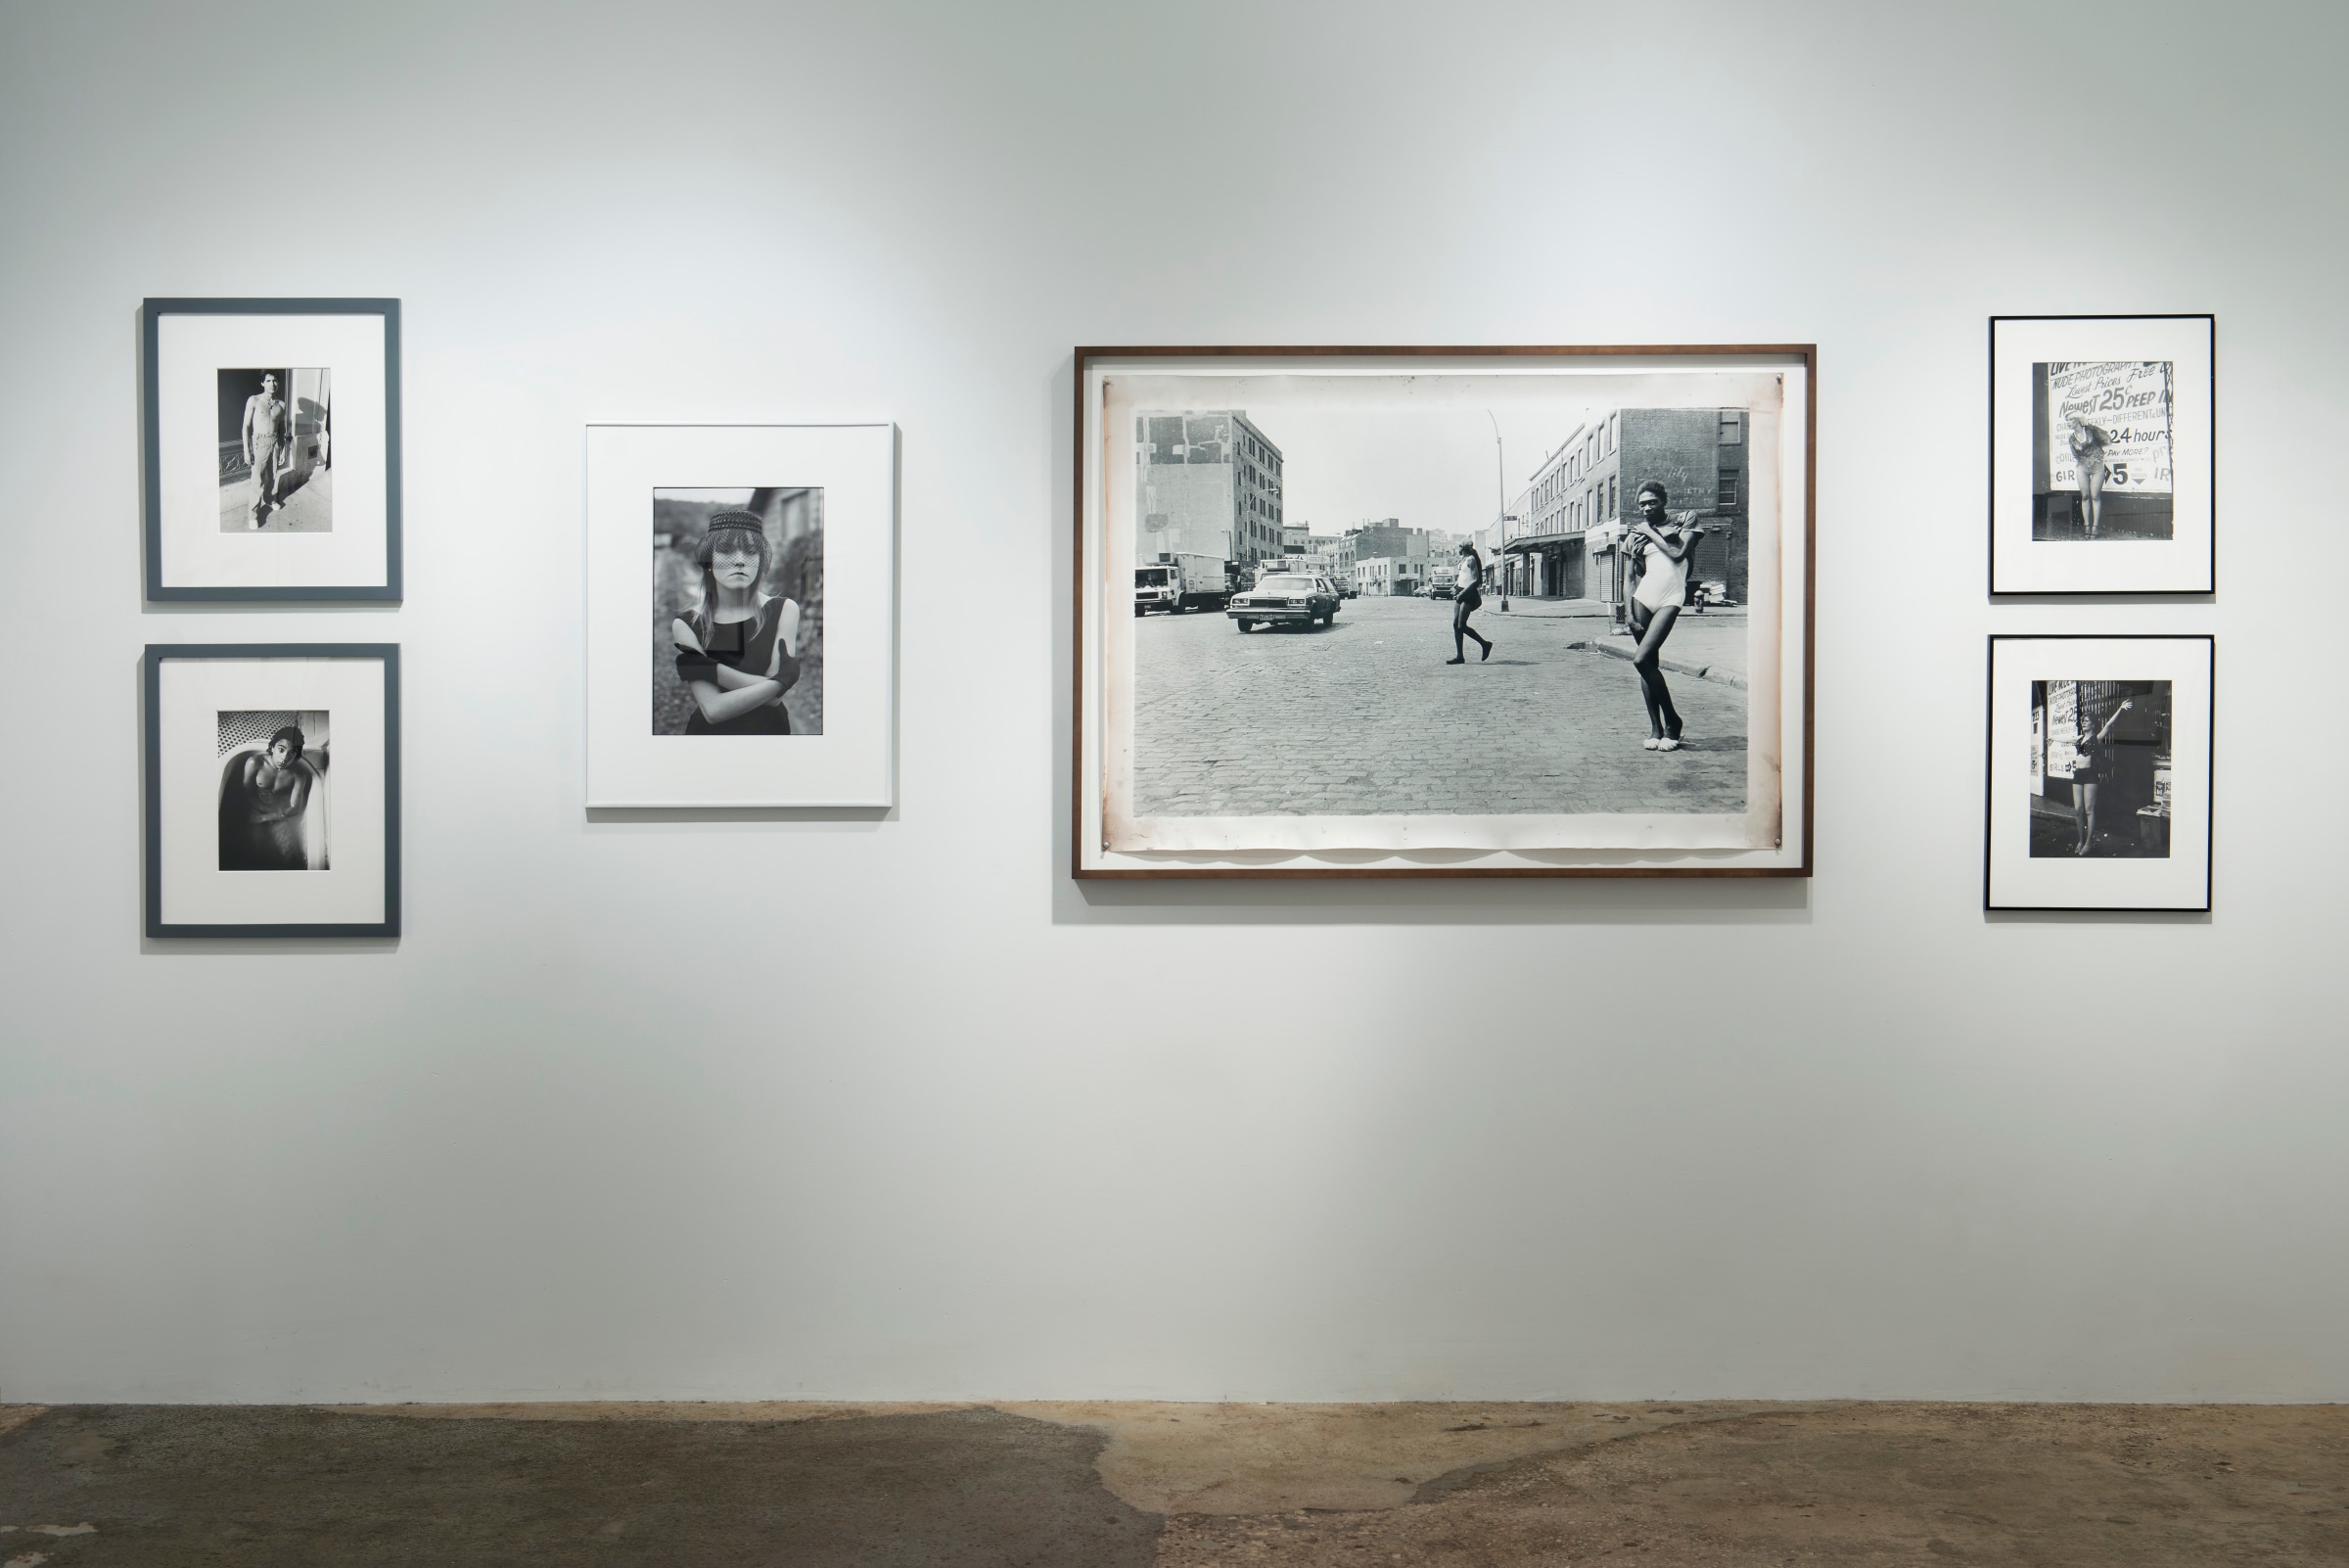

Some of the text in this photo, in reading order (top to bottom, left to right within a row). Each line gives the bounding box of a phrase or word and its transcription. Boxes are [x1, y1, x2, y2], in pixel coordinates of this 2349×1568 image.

[2126, 392, 2156, 408] PEEP
[2109, 427, 2133, 443] 24
[2055, 470, 2076, 483] GIR
[2112, 462, 2129, 485] 5
